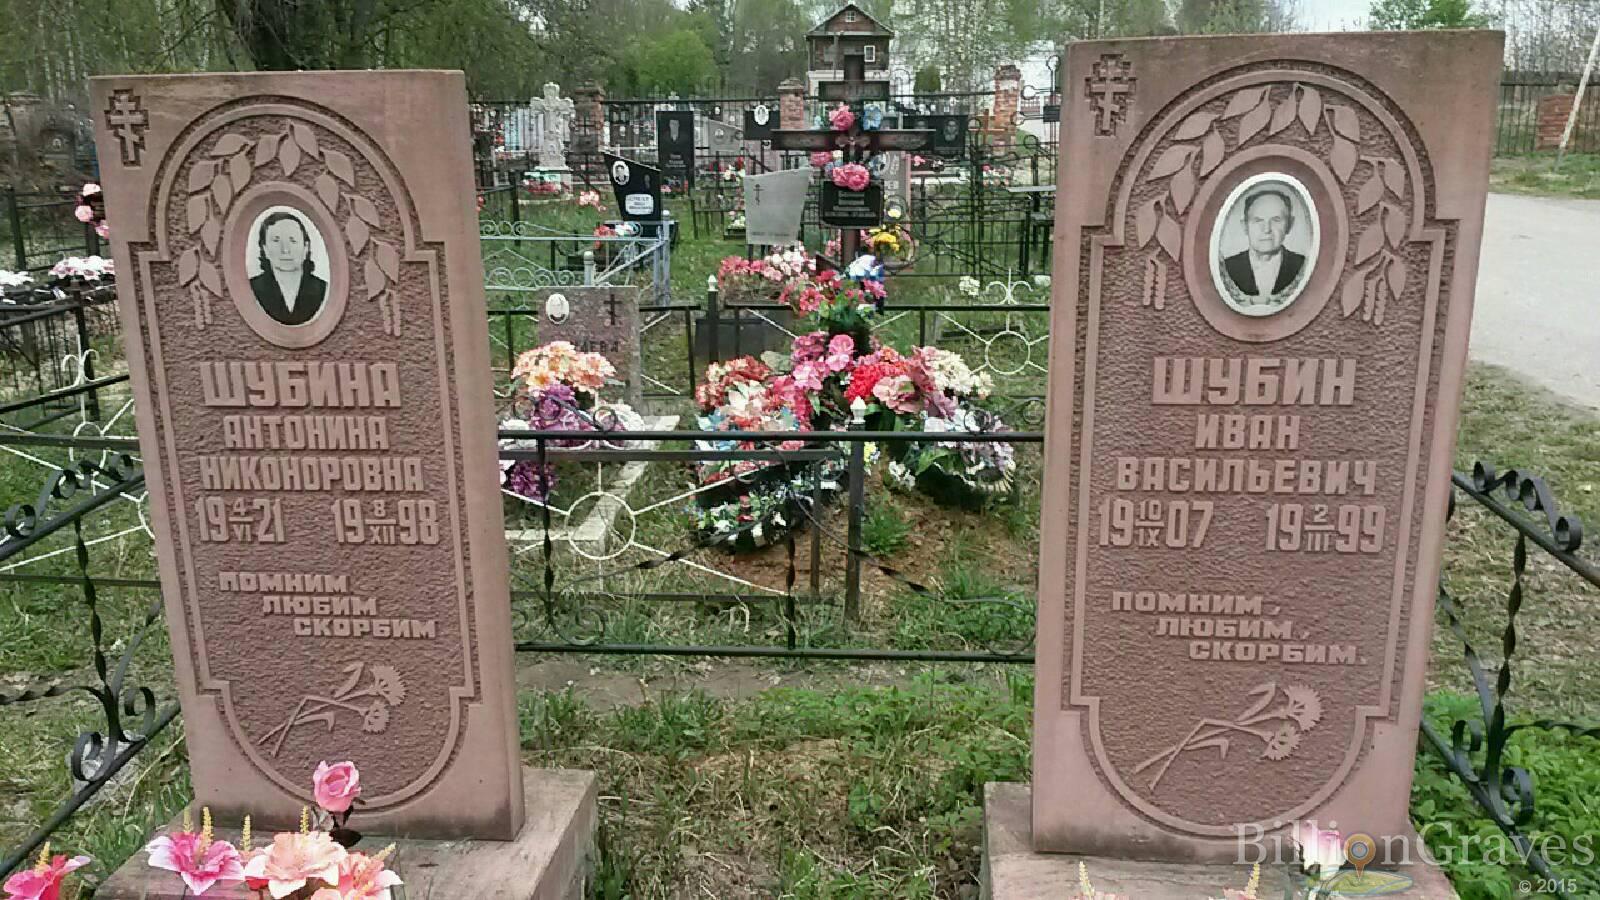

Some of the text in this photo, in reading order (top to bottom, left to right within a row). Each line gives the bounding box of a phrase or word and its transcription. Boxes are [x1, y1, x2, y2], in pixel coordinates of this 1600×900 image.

[200, 361, 401, 408] ШУБИНА
[1151, 356, 1357, 406] ШУБИН
[223, 415, 389, 450] АНТОНИНА
[1195, 414, 1300, 450] ИВАН
[199, 455, 425, 492] НИКОНОРОВНА
[1117, 456, 1377, 495] ВАСИЛЬЕВИЧ
[219, 571, 349, 593] ПОМНИМ
[263, 595, 377, 616] ЛЮБИМ
[293, 617, 437, 639] СКОРБИМ
